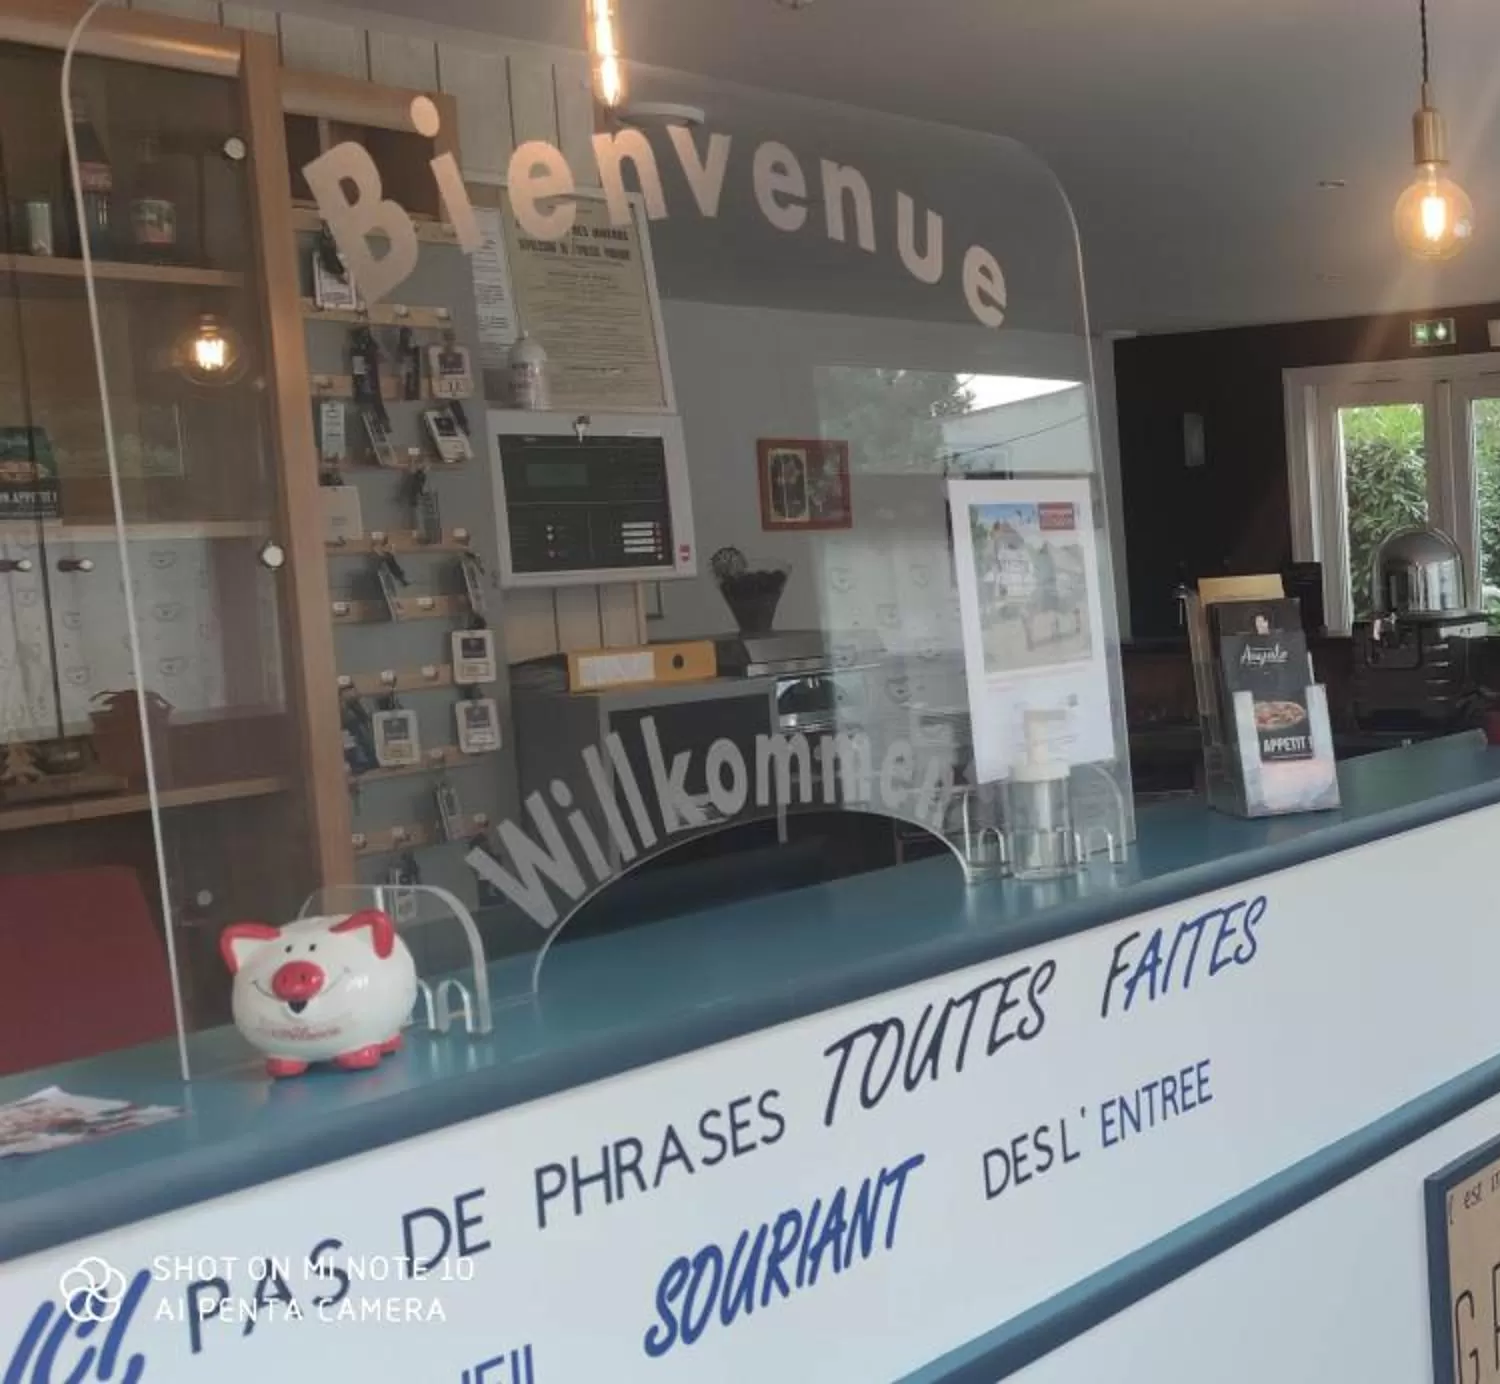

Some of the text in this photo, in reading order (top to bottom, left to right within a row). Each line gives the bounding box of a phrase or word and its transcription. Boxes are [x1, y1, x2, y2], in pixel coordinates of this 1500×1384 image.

[302, 95, 1007, 328] Bienvenue
[465, 716, 958, 929] Willkommen
[186, 1238, 350, 1354] PAS
[401, 1188, 492, 1279] DE
[534, 1089, 787, 1229] PHRASES
[824, 960, 1056, 1127] TOUTES
[1102, 895, 1268, 1019] FAITES
[643, 1153, 926, 1358] SOURIANT
